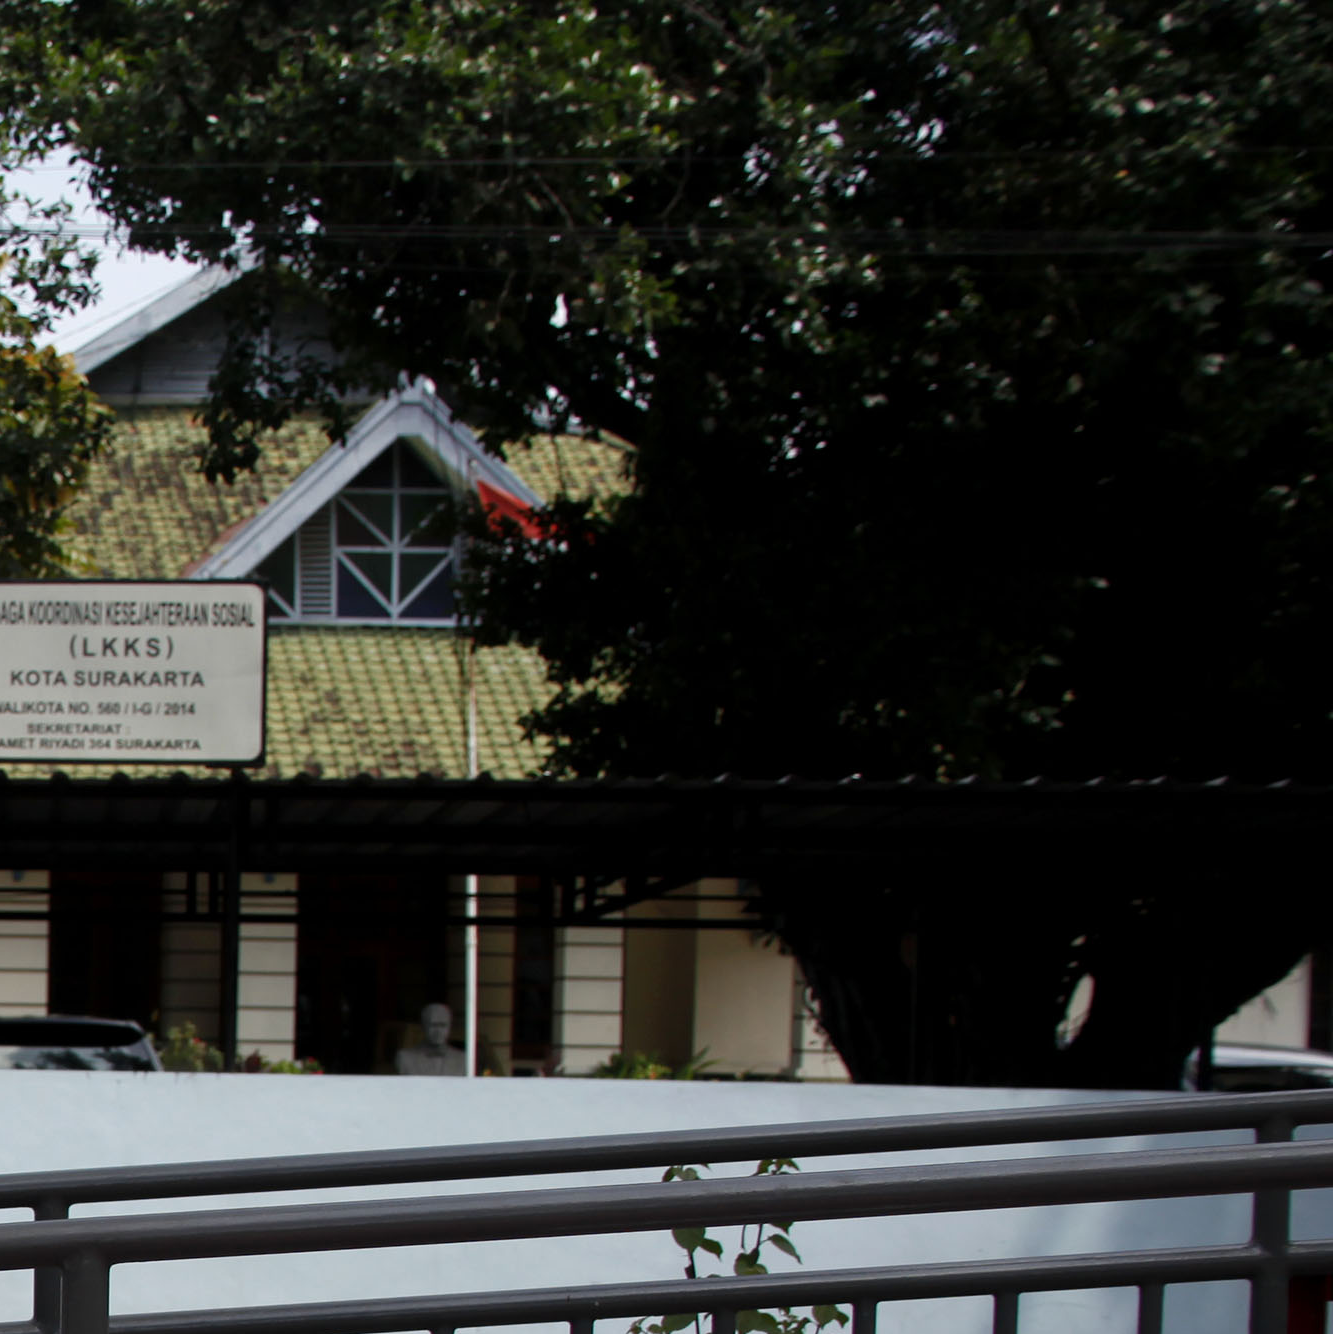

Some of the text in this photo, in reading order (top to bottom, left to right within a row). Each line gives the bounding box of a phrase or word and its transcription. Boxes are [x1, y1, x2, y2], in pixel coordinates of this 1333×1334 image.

[28, 600, 102, 625] KOORDINASI
[105, 601, 209, 626] KESEJAHTERAAN
[212, 602, 255, 627] SOSIAL
[10, 670, 205, 687] KOTA SURAKARTA
[26, 723, 121, 734] SEKRETARIAT
[40, 738, 85, 749] RIYADI
[115, 739, 201, 750] SURAKARTA
